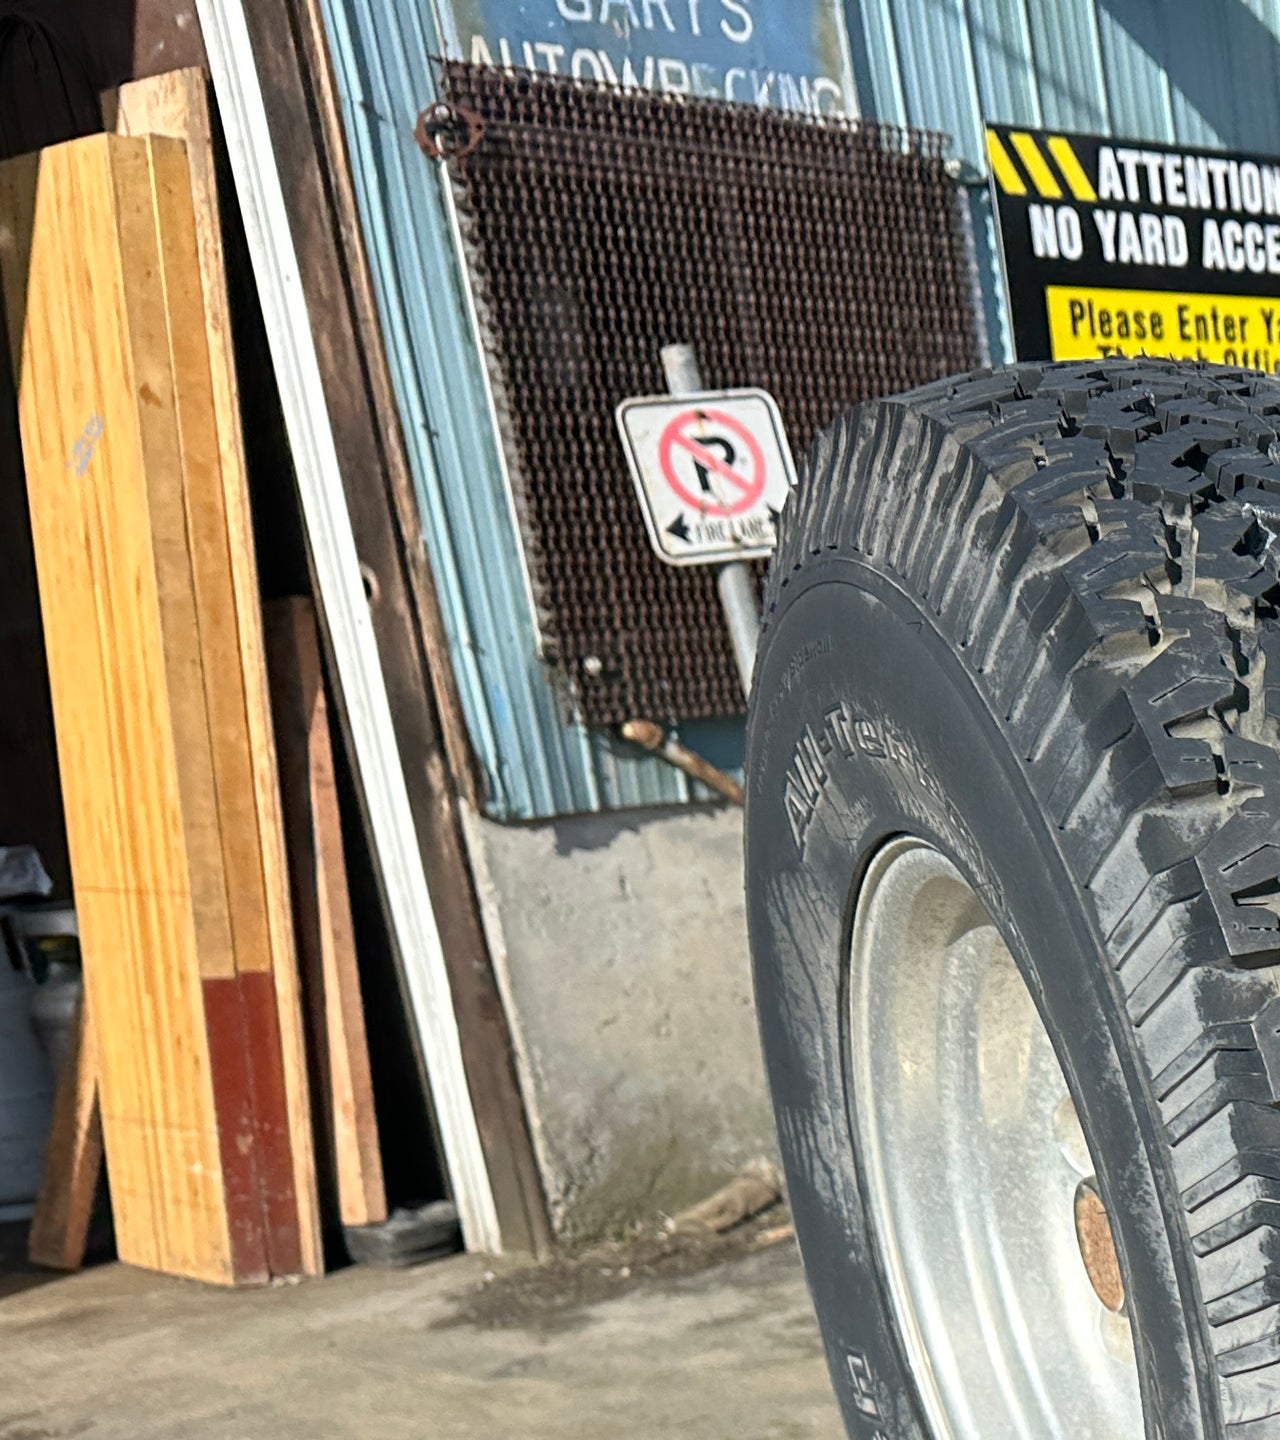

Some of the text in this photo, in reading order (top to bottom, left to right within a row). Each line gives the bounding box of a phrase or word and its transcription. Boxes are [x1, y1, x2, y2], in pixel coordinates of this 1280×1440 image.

[1027, 203, 1083, 261] NO
[1093, 208, 1189, 267] YARD
[1069, 299, 1163, 341] Please
[1177, 304, 1249, 344] Enter
